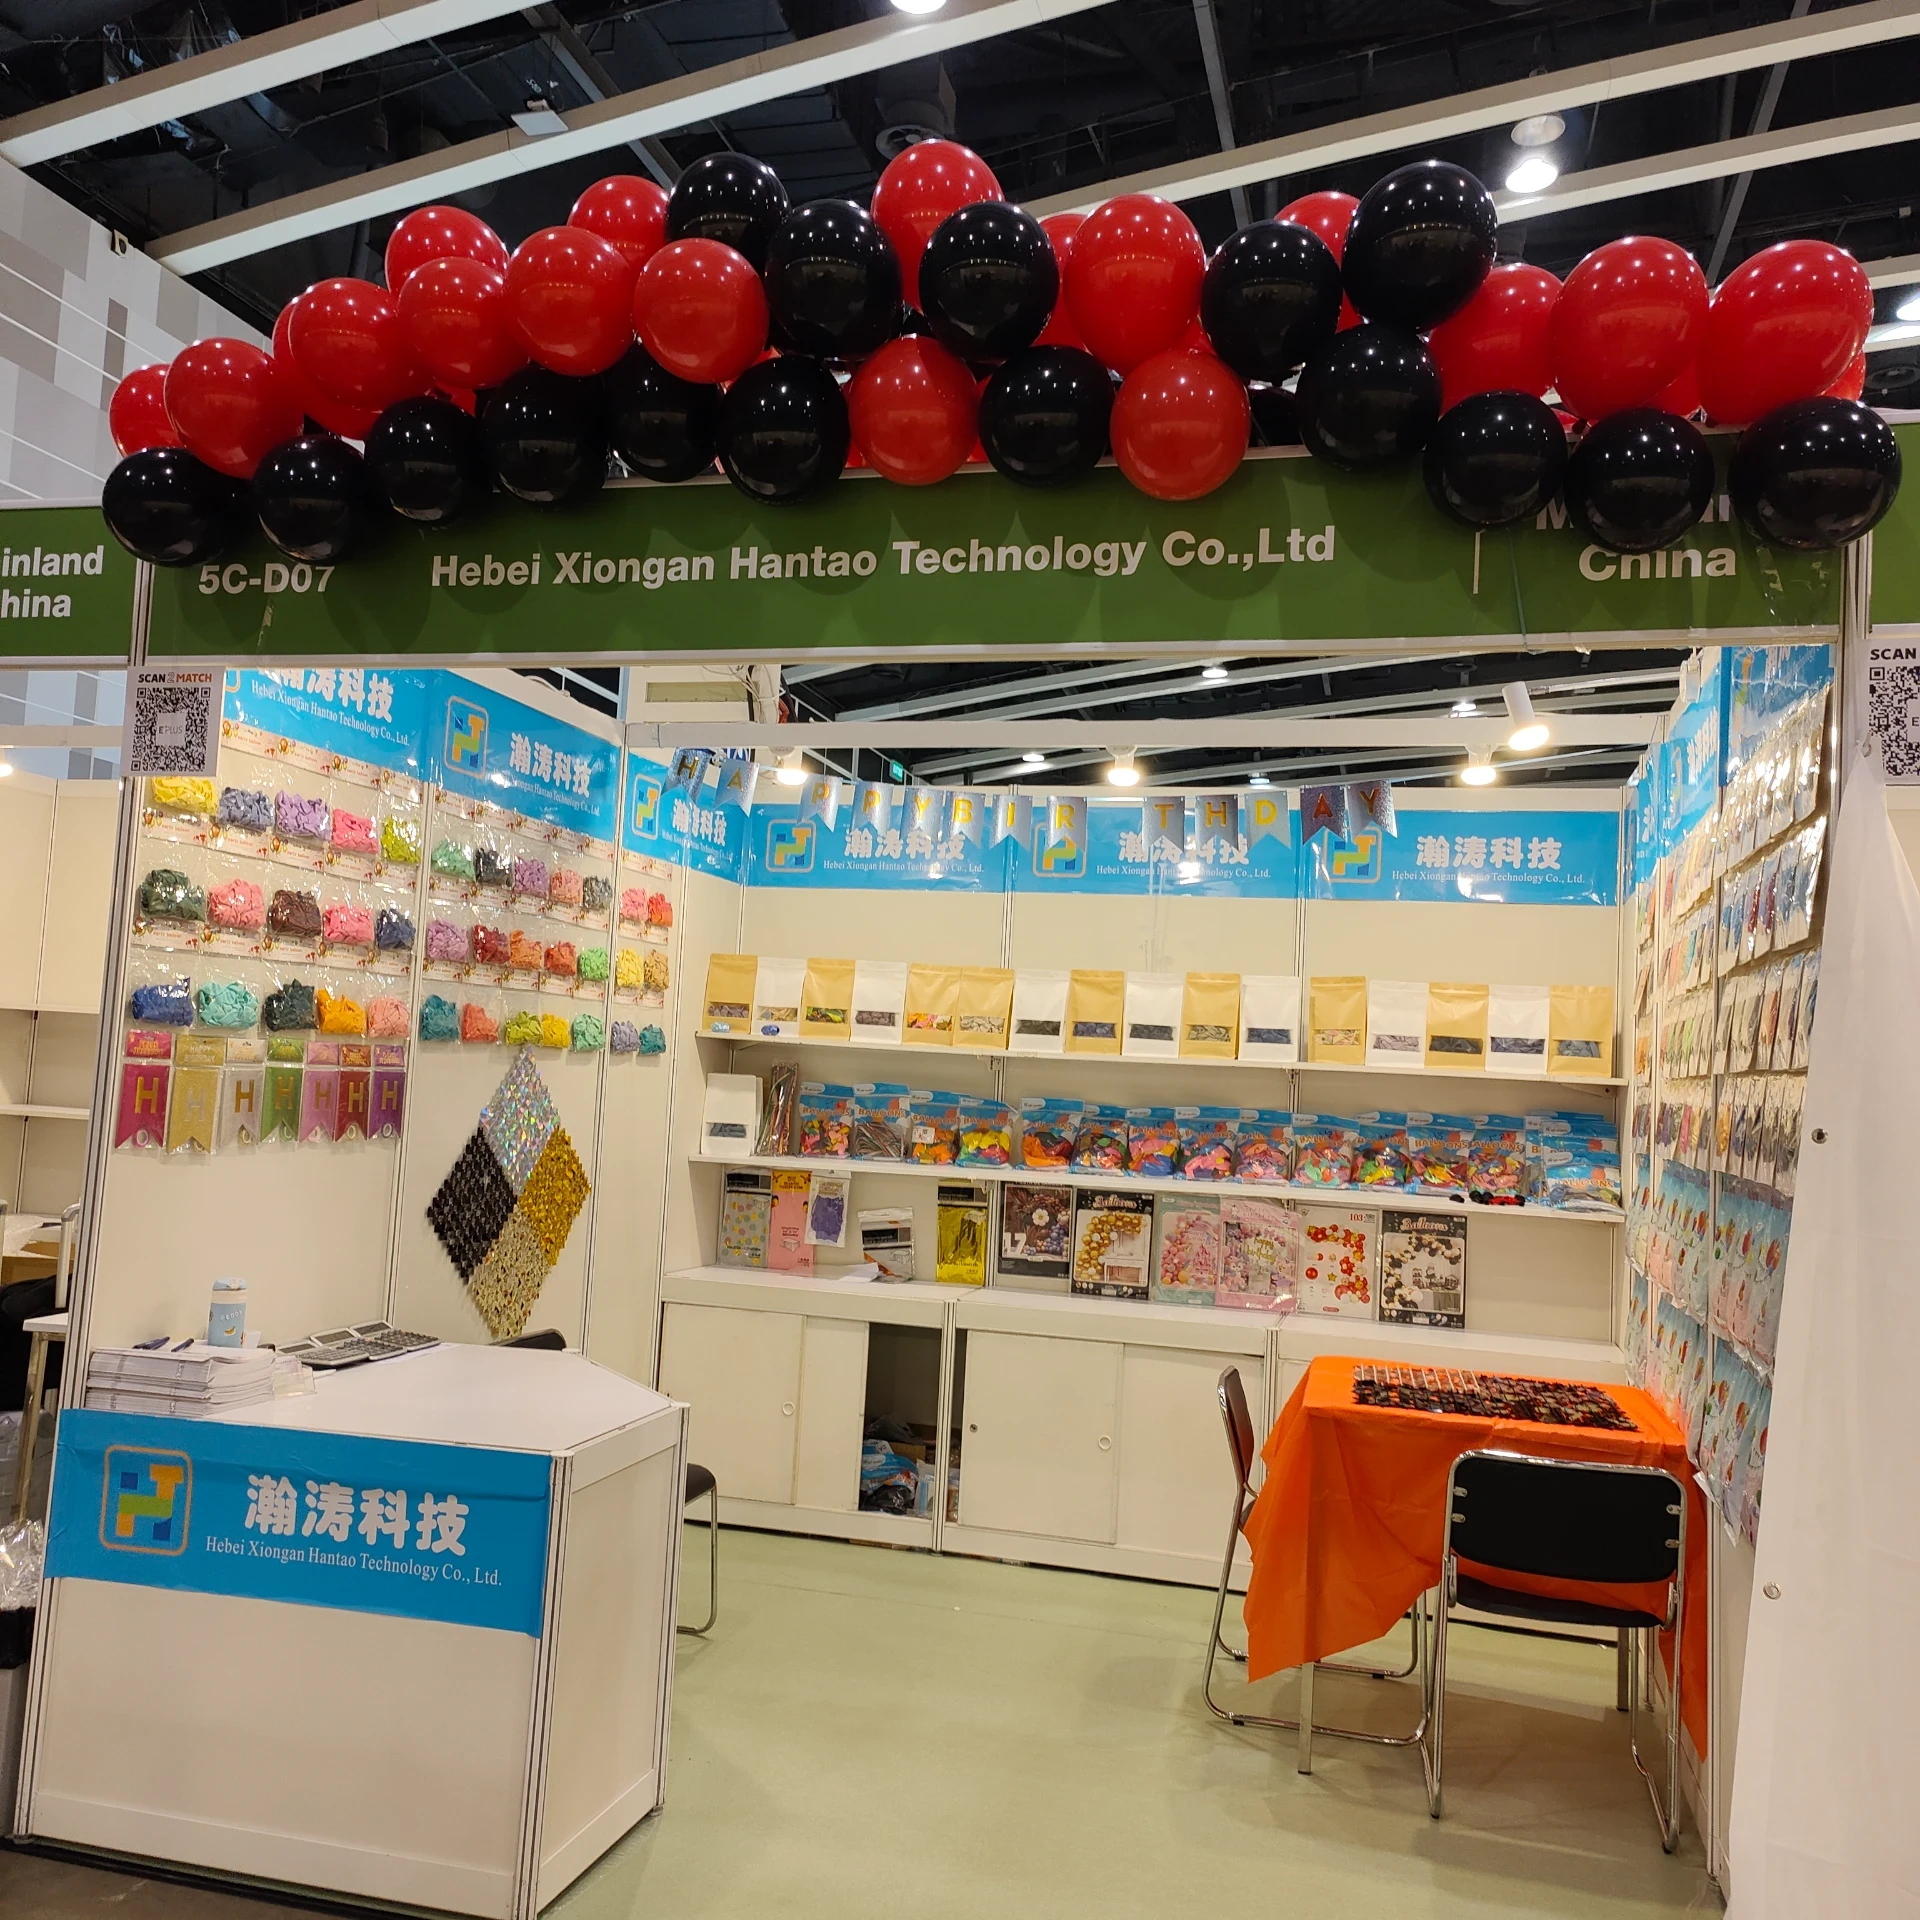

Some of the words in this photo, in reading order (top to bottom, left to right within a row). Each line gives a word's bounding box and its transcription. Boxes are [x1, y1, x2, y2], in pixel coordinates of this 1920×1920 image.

[1, 545, 103, 577] inland
[431, 553, 541, 587] Hebei
[552, 551, 714, 589] Xiongan
[729, 545, 877, 580] Hantao
[892, 534, 1147, 577] Technology
[1161, 525, 1335, 572] Co.,Ltd
[1578, 544, 1736, 582] China
[198, 563, 335, 595] 5C-D07
[251, 680, 276, 698] Hebei
[277, 690, 310, 712] Xiongan
[310, 702, 338, 723] Hantao
[339, 711, 380, 739] Technology
[380, 727, 395, 742] Co.,
[395, 731, 410, 747] Ltd.
[509, 732, 592, 798] 瀚涛科技
[823, 860, 845, 870] Hebei
[846, 861, 878, 872] Xiongan
[878, 861, 905, 871] Hantao
[1416, 835, 1563, 870] 瀚涛科技
[1096, 865, 1120, 875] Hebei
[1254, 869, 1271, 879] Ltd.
[1392, 871, 1418, 880] Hebei
[1419, 872, 1457, 883] Xiongan
[1491, 872, 1544, 884] Technology
[1545, 874, 1565, 884] Co.,
[1566, 874, 1585, 884] Ltd.
[135, 1076, 159, 1114] H
[185, 1087, 210, 1122] H
[235, 1079, 255, 1113] H
[275, 1076, 295, 1110] H
[314, 1079, 332, 1110] H
[348, 1081, 364, 1113] H
[381, 1080, 399, 1111] H
[858, 1107, 906, 1118] BALLOONS
[1415, 1138, 1468, 1149] BALLOONS
[1350, 1213, 1364, 1222] 103
[1400, 1216, 1449, 1232] Balloons
[244, 1474, 470, 1557] 瀚涛科技
[205, 1535, 245, 1556] Hebei
[247, 1539, 305, 1565] Xiongan
[308, 1545, 356, 1569] Hantao
[359, 1552, 440, 1582] Technology
[441, 1562, 471, 1585] Co.,
[474, 1565, 503, 1587] Ltd.
